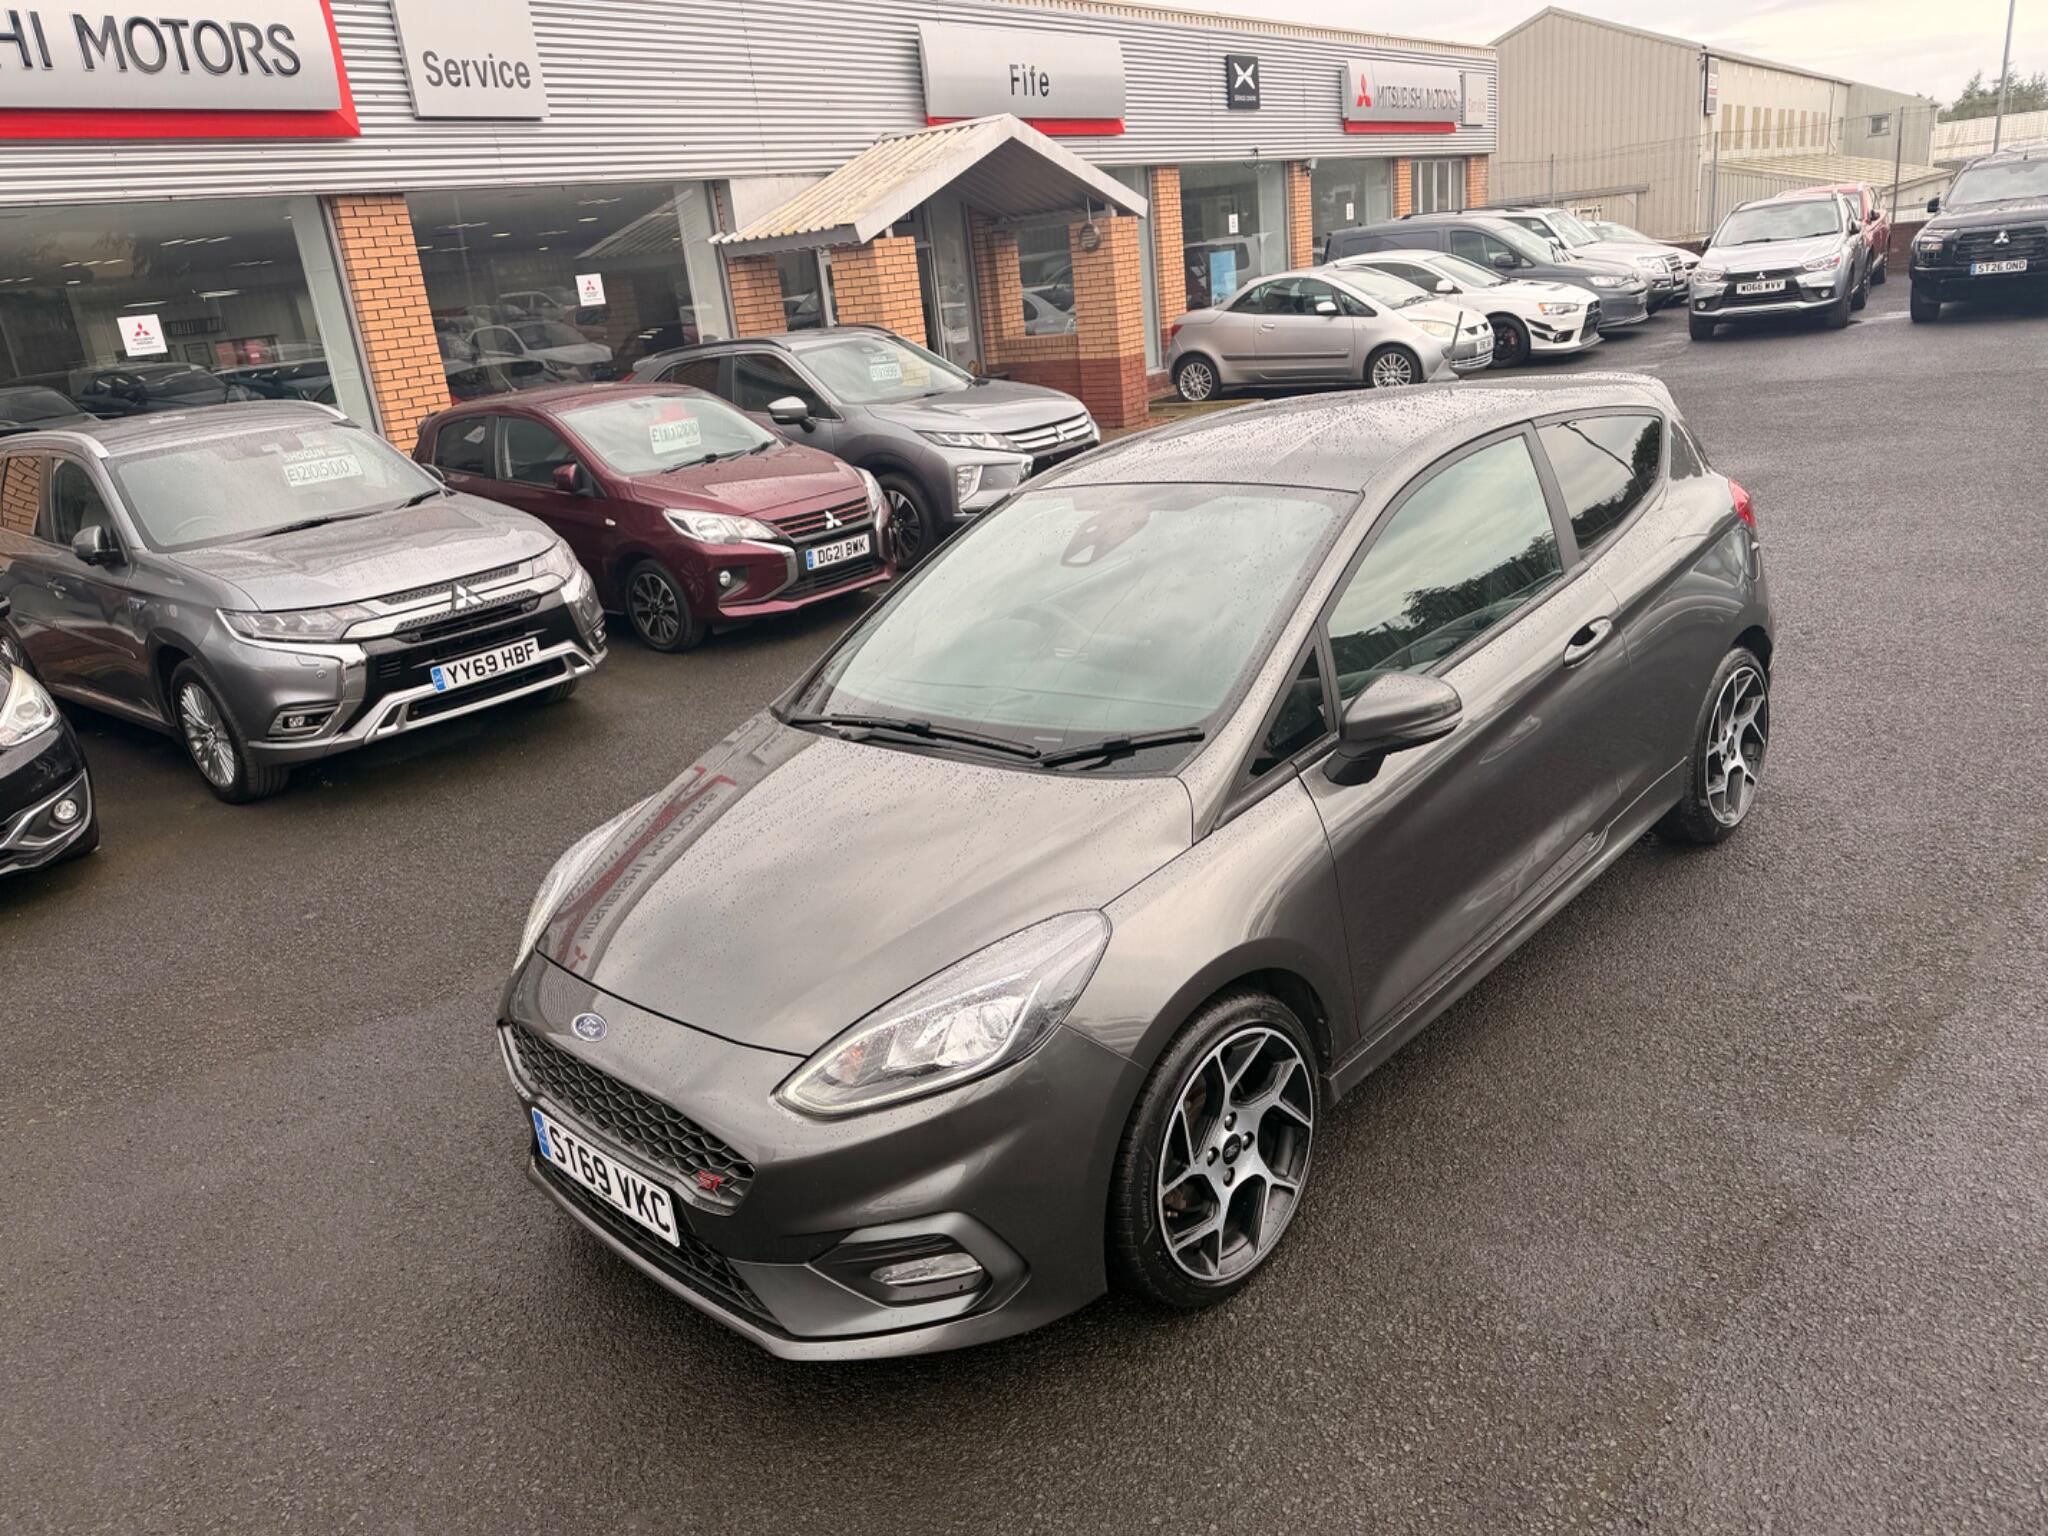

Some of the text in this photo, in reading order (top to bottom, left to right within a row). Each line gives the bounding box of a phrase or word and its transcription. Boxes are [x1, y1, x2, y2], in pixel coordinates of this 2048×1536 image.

[70, 13, 301, 77] MOTORS
[422, 50, 531, 89] Service
[1009, 63, 1050, 97] Fife
[817, 537, 866, 564] DG21 BWK
[446, 641, 534, 684] YY69 HBF
[548, 1125, 671, 1234] ST69 VKC
